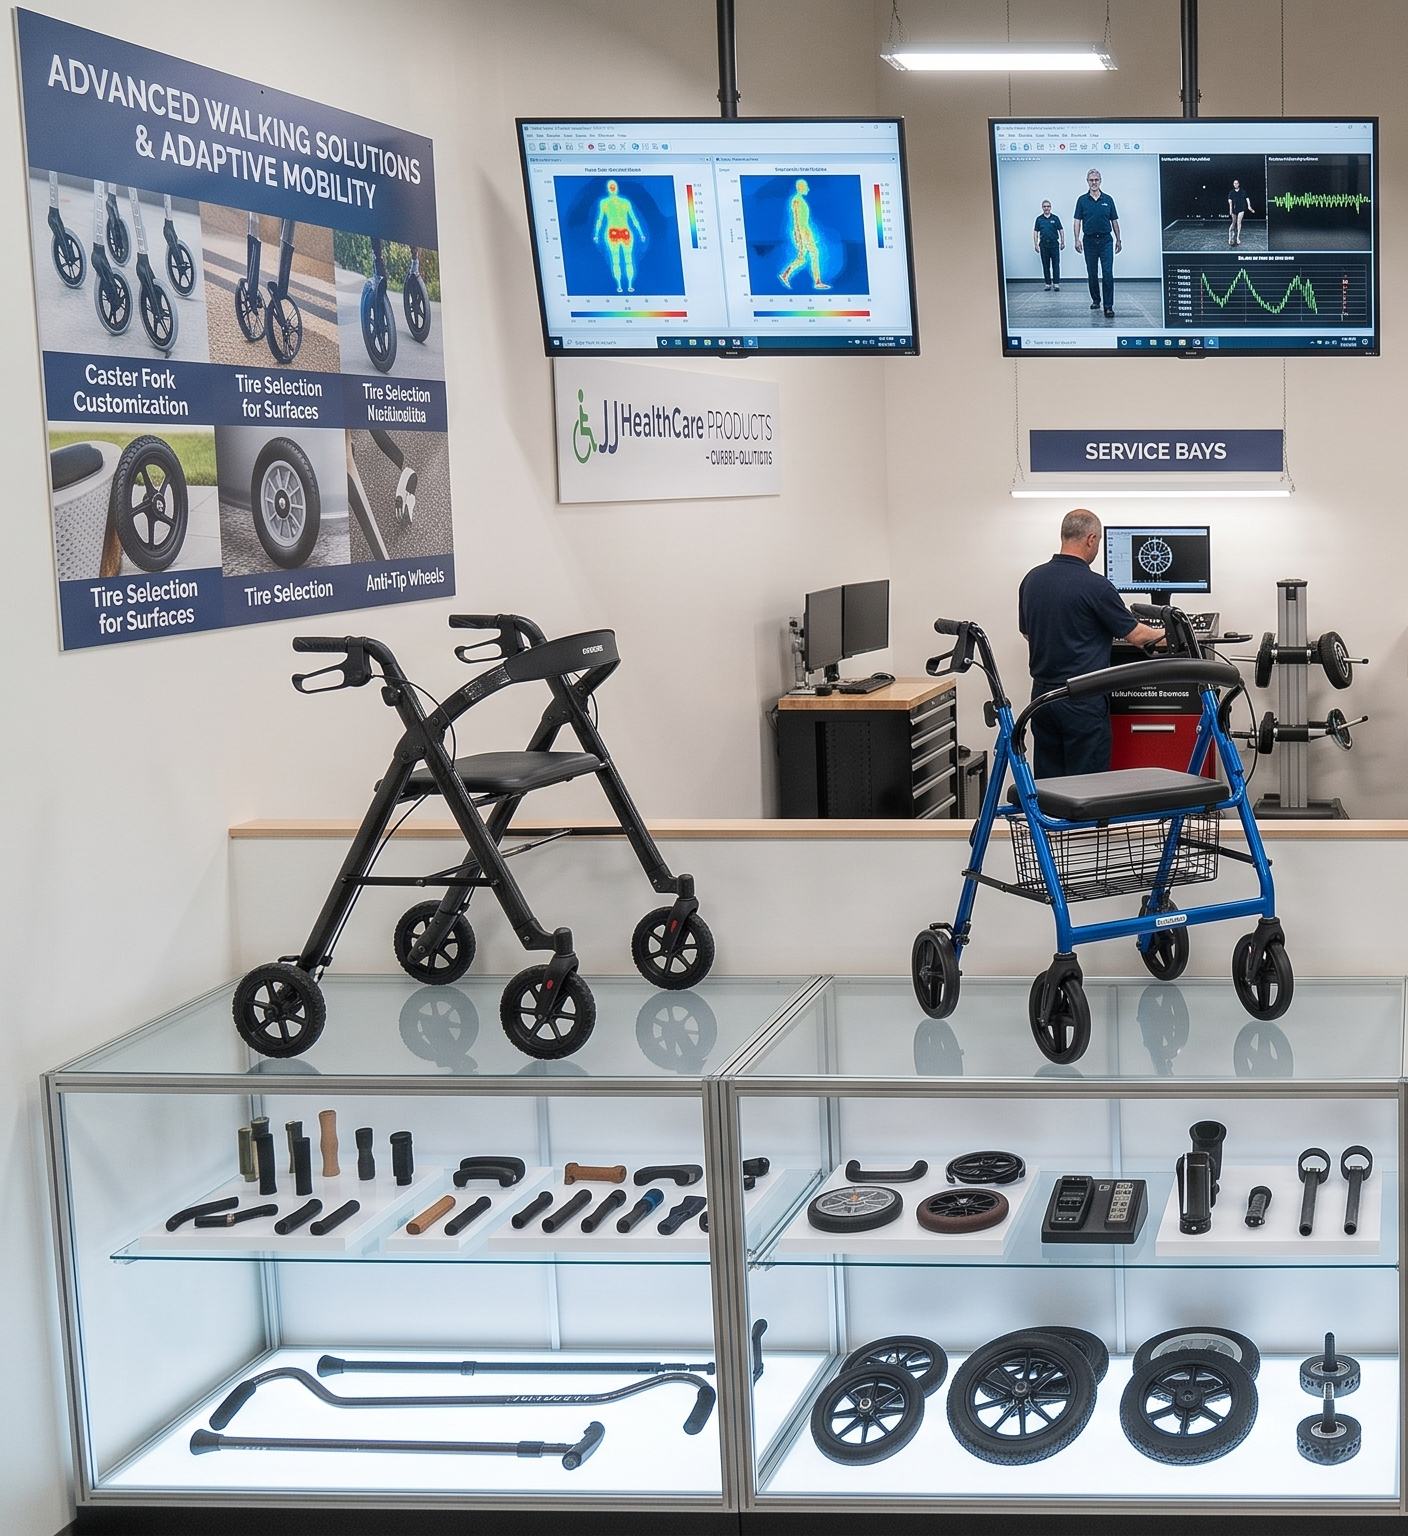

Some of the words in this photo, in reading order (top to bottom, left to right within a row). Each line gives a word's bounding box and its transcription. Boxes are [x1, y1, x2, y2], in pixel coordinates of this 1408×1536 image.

[48, 54, 200, 125] ADVANCED
[203, 98, 311, 155] WALKING
[316, 132, 422, 185] SOLUTIONS
[135, 124, 155, 158] &
[161, 131, 278, 188] ADAPTIVE
[283, 165, 376, 209] MOBILITY
[85, 364, 138, 388] Caster
[141, 368, 176, 390] Fork
[236, 374, 263, 395] Tire
[265, 375, 323, 398] Selection
[73, 392, 189, 416] Customization
[362, 383, 383, 401] Tire
[386, 384, 431, 403] Selection
[242, 398, 262, 419] for
[264, 399, 319, 420] Surfaces
[707, 410, 773, 441] PRODUCTS
[1085, 442, 1171, 460] SERVICE
[1175, 442, 1227, 460] BAYS
[366, 573, 407, 593] Anti-Tip
[408, 567, 445, 587] Wheels
[90, 586, 123, 609] Tire
[126, 580, 199, 604] Selection
[244, 586, 272, 607] Tire
[275, 580, 334, 602] Selection
[98, 614, 123, 635] for
[126, 606, 196, 631] Surfaces
